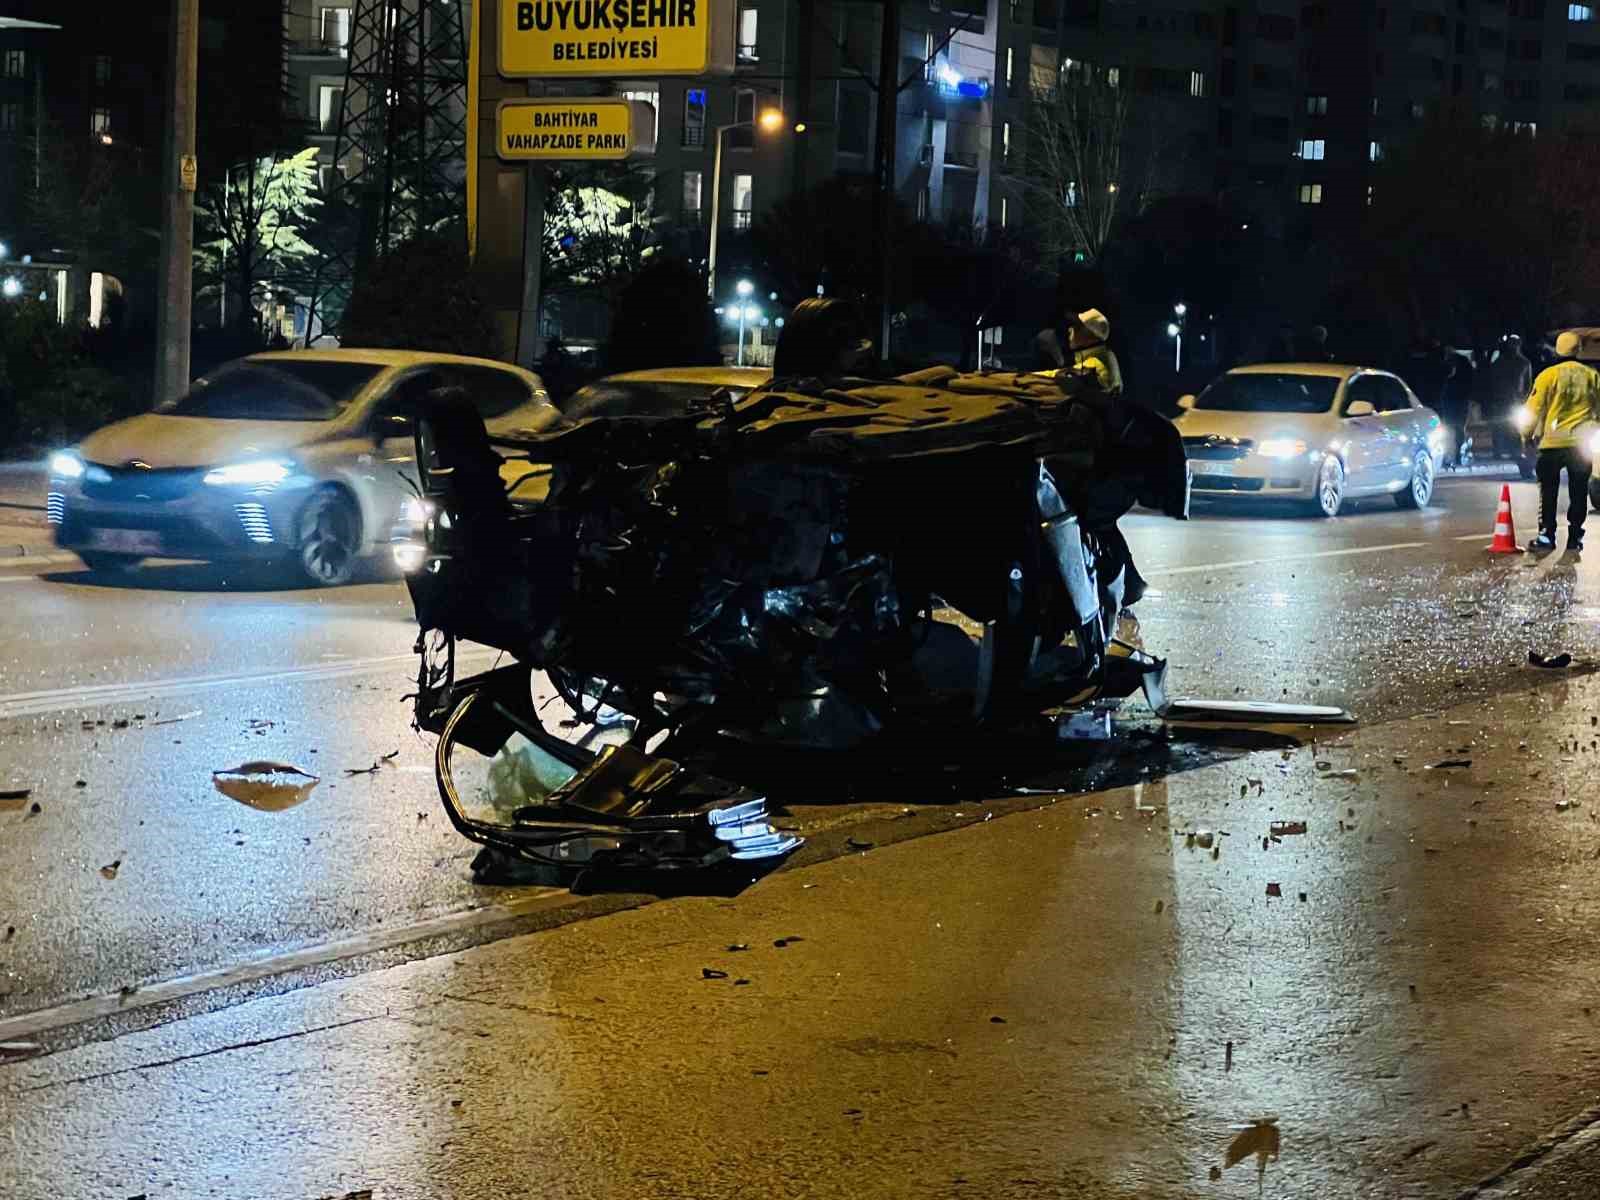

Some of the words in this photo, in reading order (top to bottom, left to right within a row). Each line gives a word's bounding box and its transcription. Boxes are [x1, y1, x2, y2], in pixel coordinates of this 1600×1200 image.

[553, 36, 657, 61] BELEDİYESİ
[534, 109, 598, 128] BAHTİYAR
[507, 134, 583, 149] VAHAPZADE
[587, 134, 626, 149] PARKI
